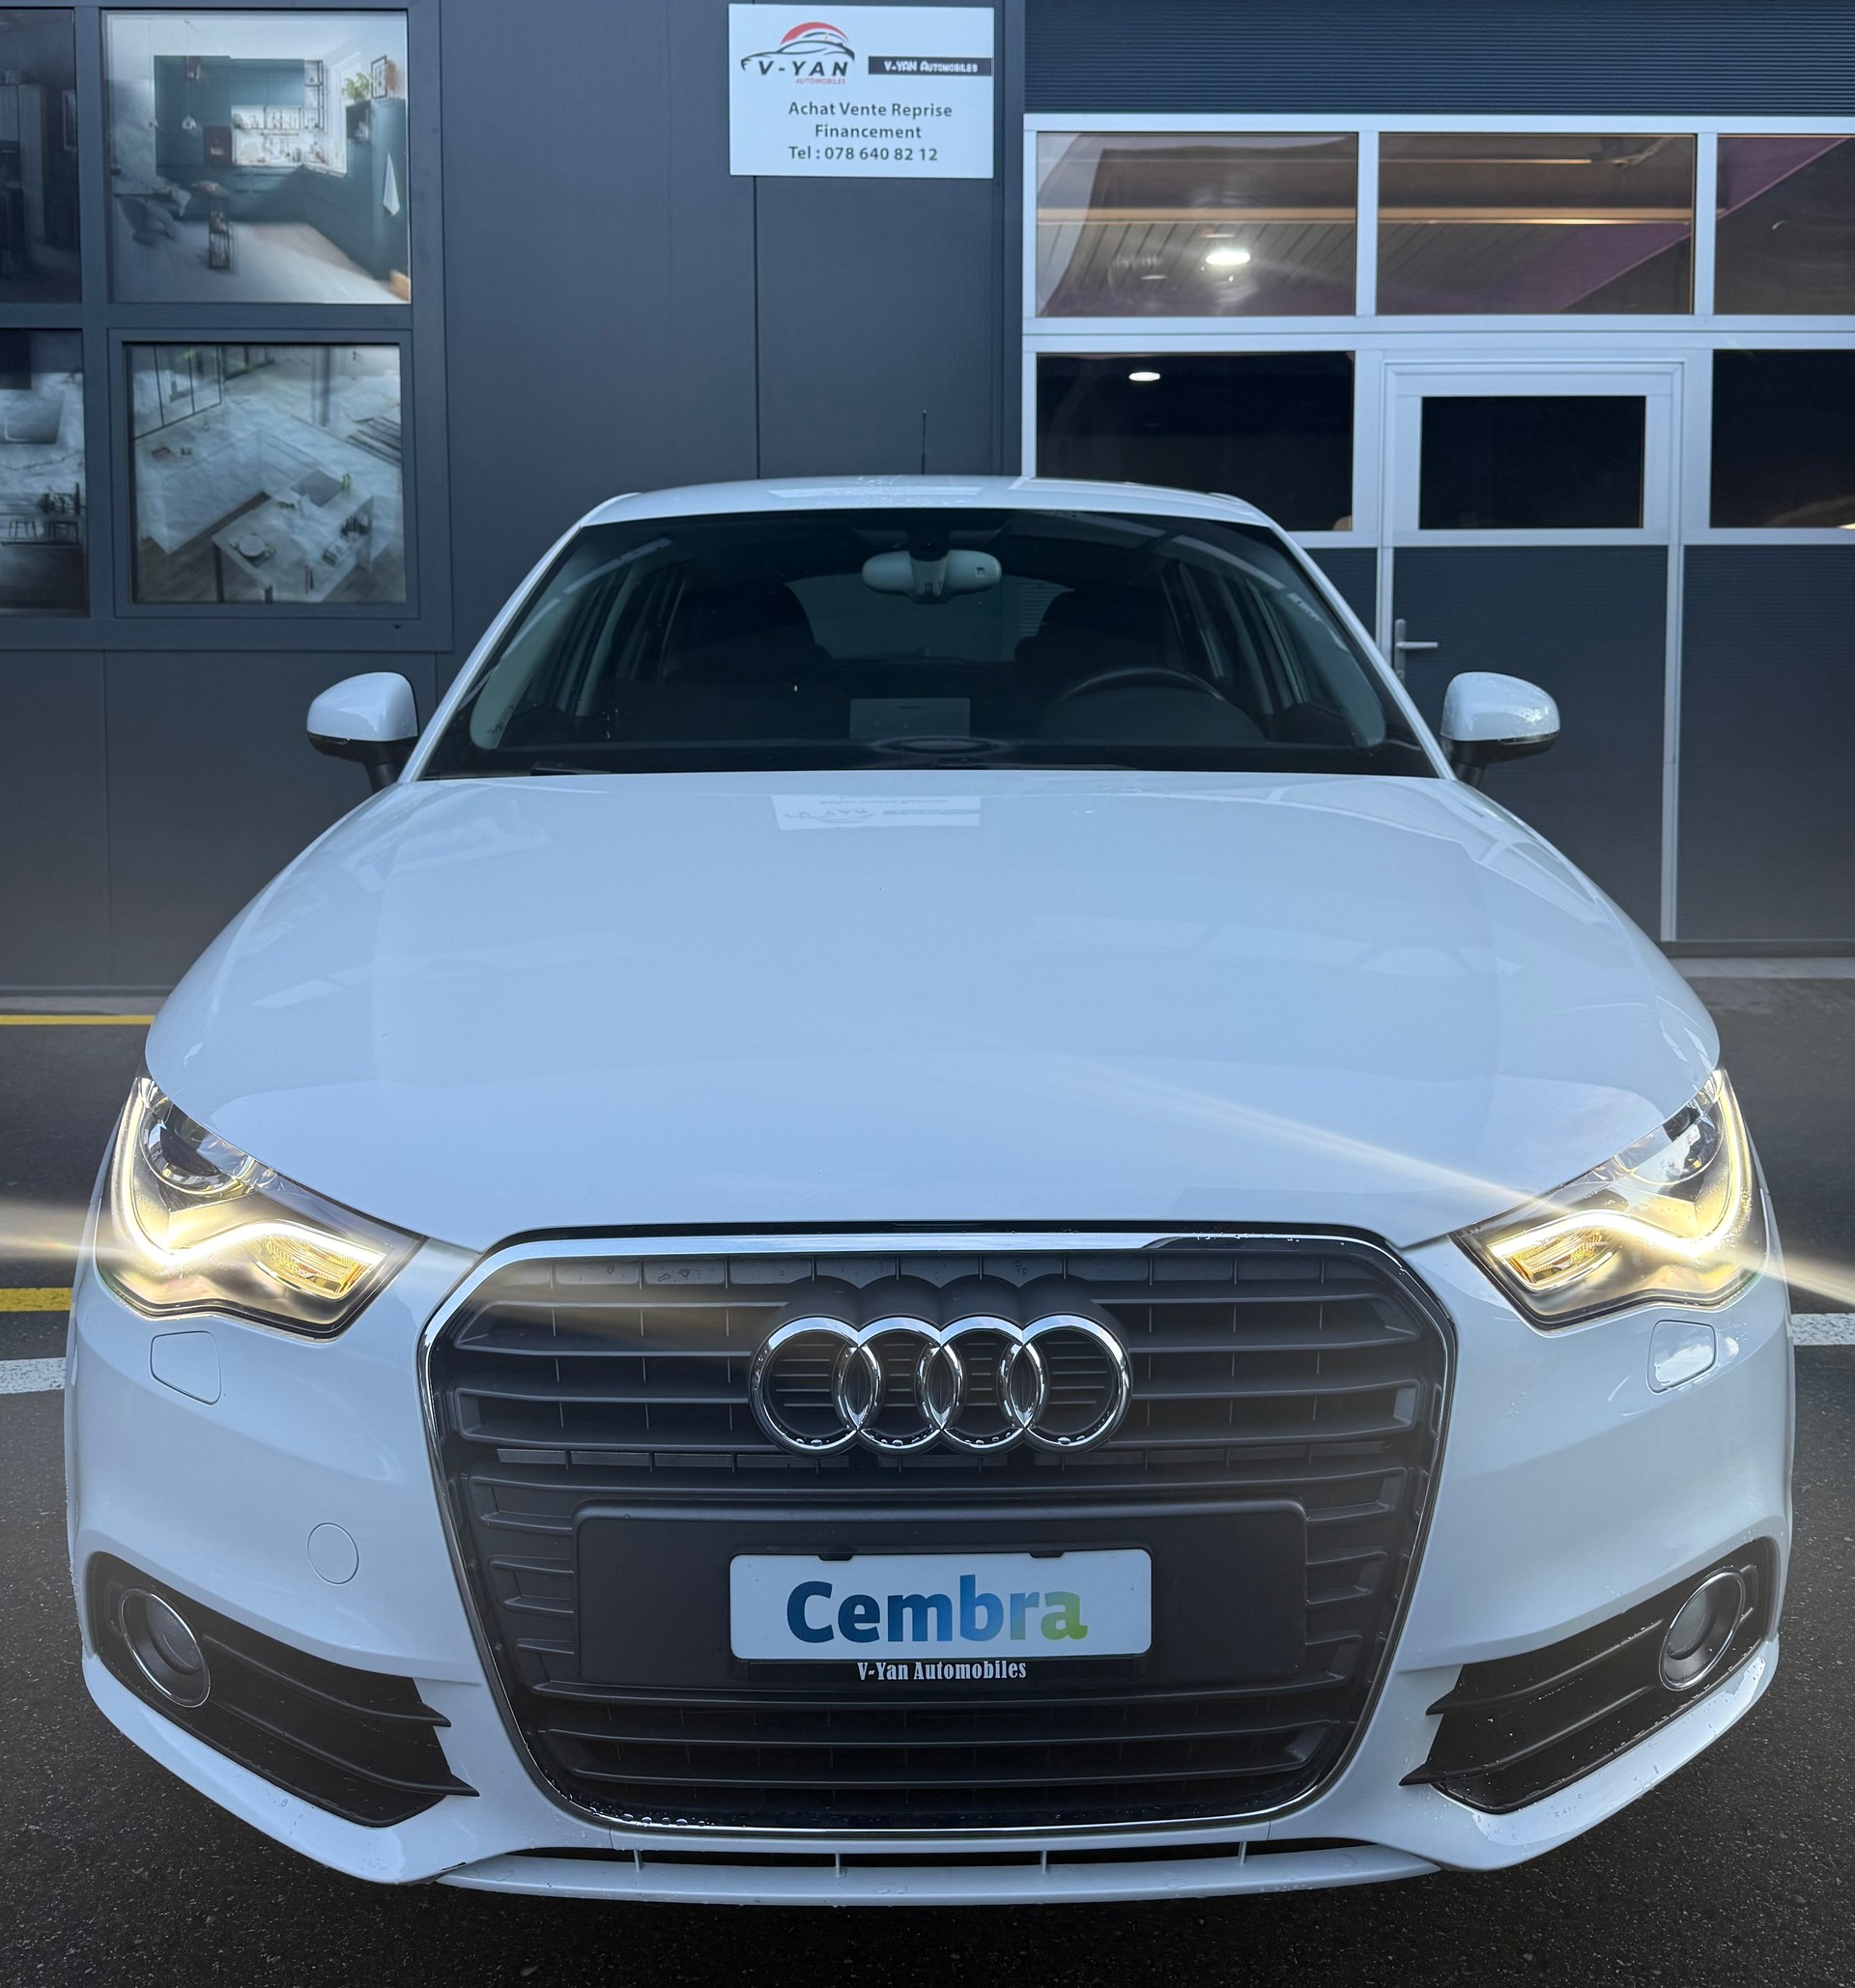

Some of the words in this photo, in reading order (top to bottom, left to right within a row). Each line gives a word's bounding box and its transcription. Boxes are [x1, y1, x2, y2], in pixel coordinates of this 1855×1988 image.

[758, 60, 848, 76] V-YAN
[788, 101, 836, 116] Achat
[840, 102, 887, 116] Vente
[892, 103, 953, 120] Reprise
[815, 125, 922, 139] Financement
[824, 147, 855, 160] 078
[859, 148, 890, 160] 640
[894, 148, 914, 160] 82
[919, 148, 938, 161] 12
[786, 1574, 1089, 1643] Cembra
[857, 1661, 909, 1681] V-Yan
[913, 1661, 1027, 1681] Automobiles
